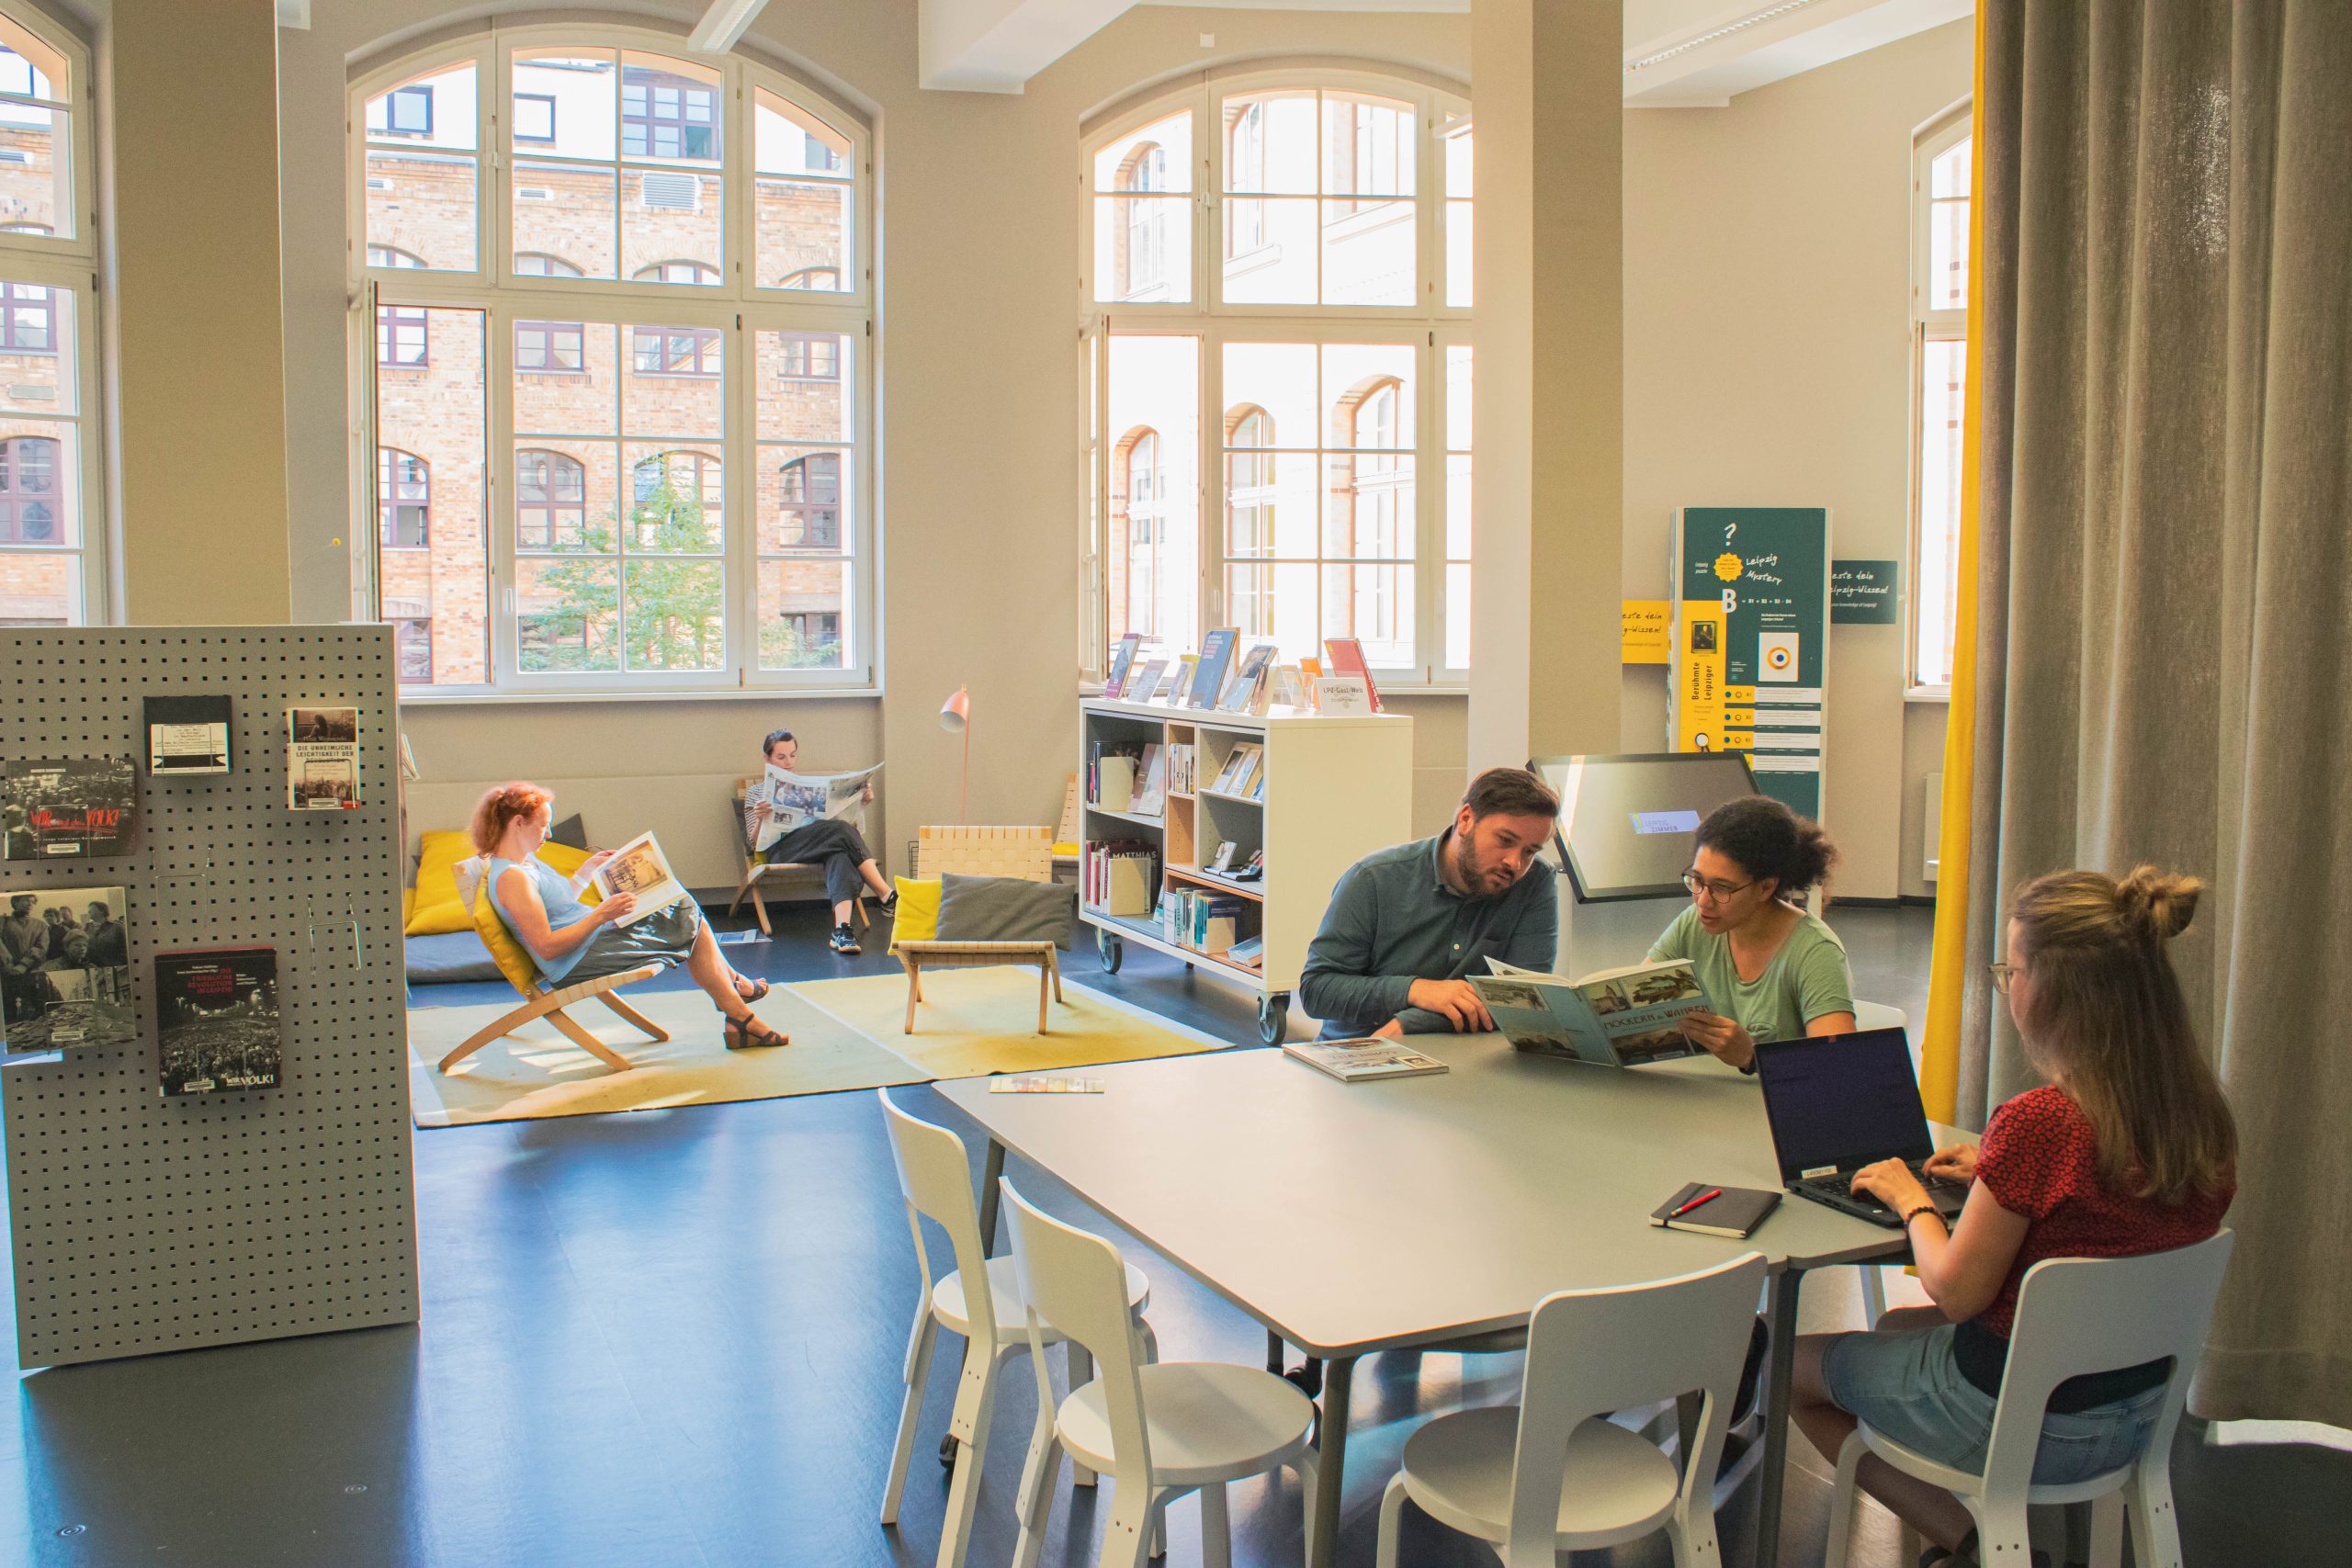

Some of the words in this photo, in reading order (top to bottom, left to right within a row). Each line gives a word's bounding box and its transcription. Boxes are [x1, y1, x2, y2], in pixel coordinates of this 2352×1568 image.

[1724, 522, 1737, 547] ?
[1746, 553, 1778, 567] Leipzig
[1746, 570, 1782, 586] Mystery
[1832, 570, 1853, 580] este
[1856, 570, 1874, 580] dein
[1721, 588, 1737, 613] B
[1645, 611, 1662, 620] dein
[1623, 626, 1662, 637] g-Wissen!
[1690, 661, 1701, 701] Berühmte
[1703, 664, 1714, 701] Leipziger
[30, 808, 52, 826] WIR
[1113, 851, 1158, 860] MATTHIAS
[240, 1074, 274, 1086] VOLK!
